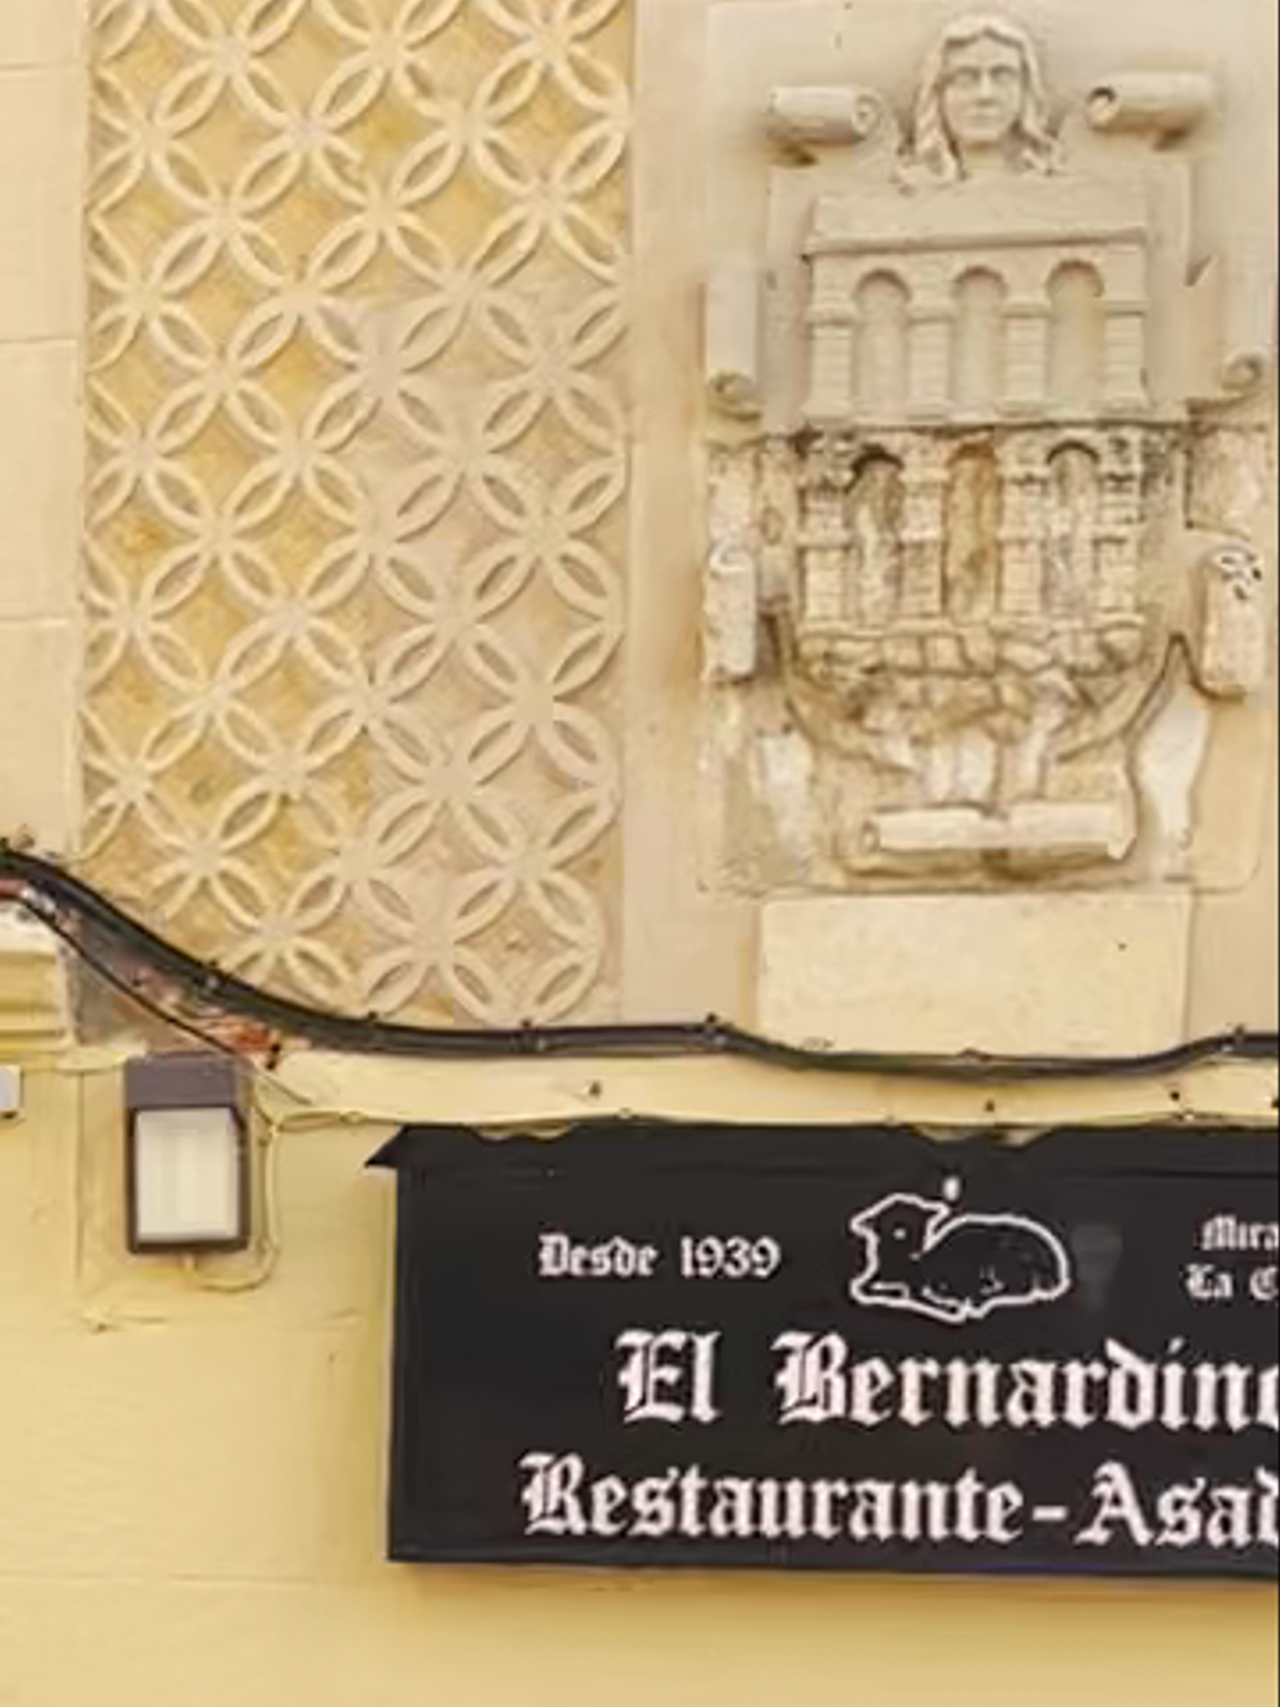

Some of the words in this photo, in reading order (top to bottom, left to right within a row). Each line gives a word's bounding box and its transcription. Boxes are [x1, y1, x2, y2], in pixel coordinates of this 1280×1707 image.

[538, 1233, 658, 1278] Desde
[680, 1236, 781, 1278] 1939
[616, 1329, 720, 1424] El
